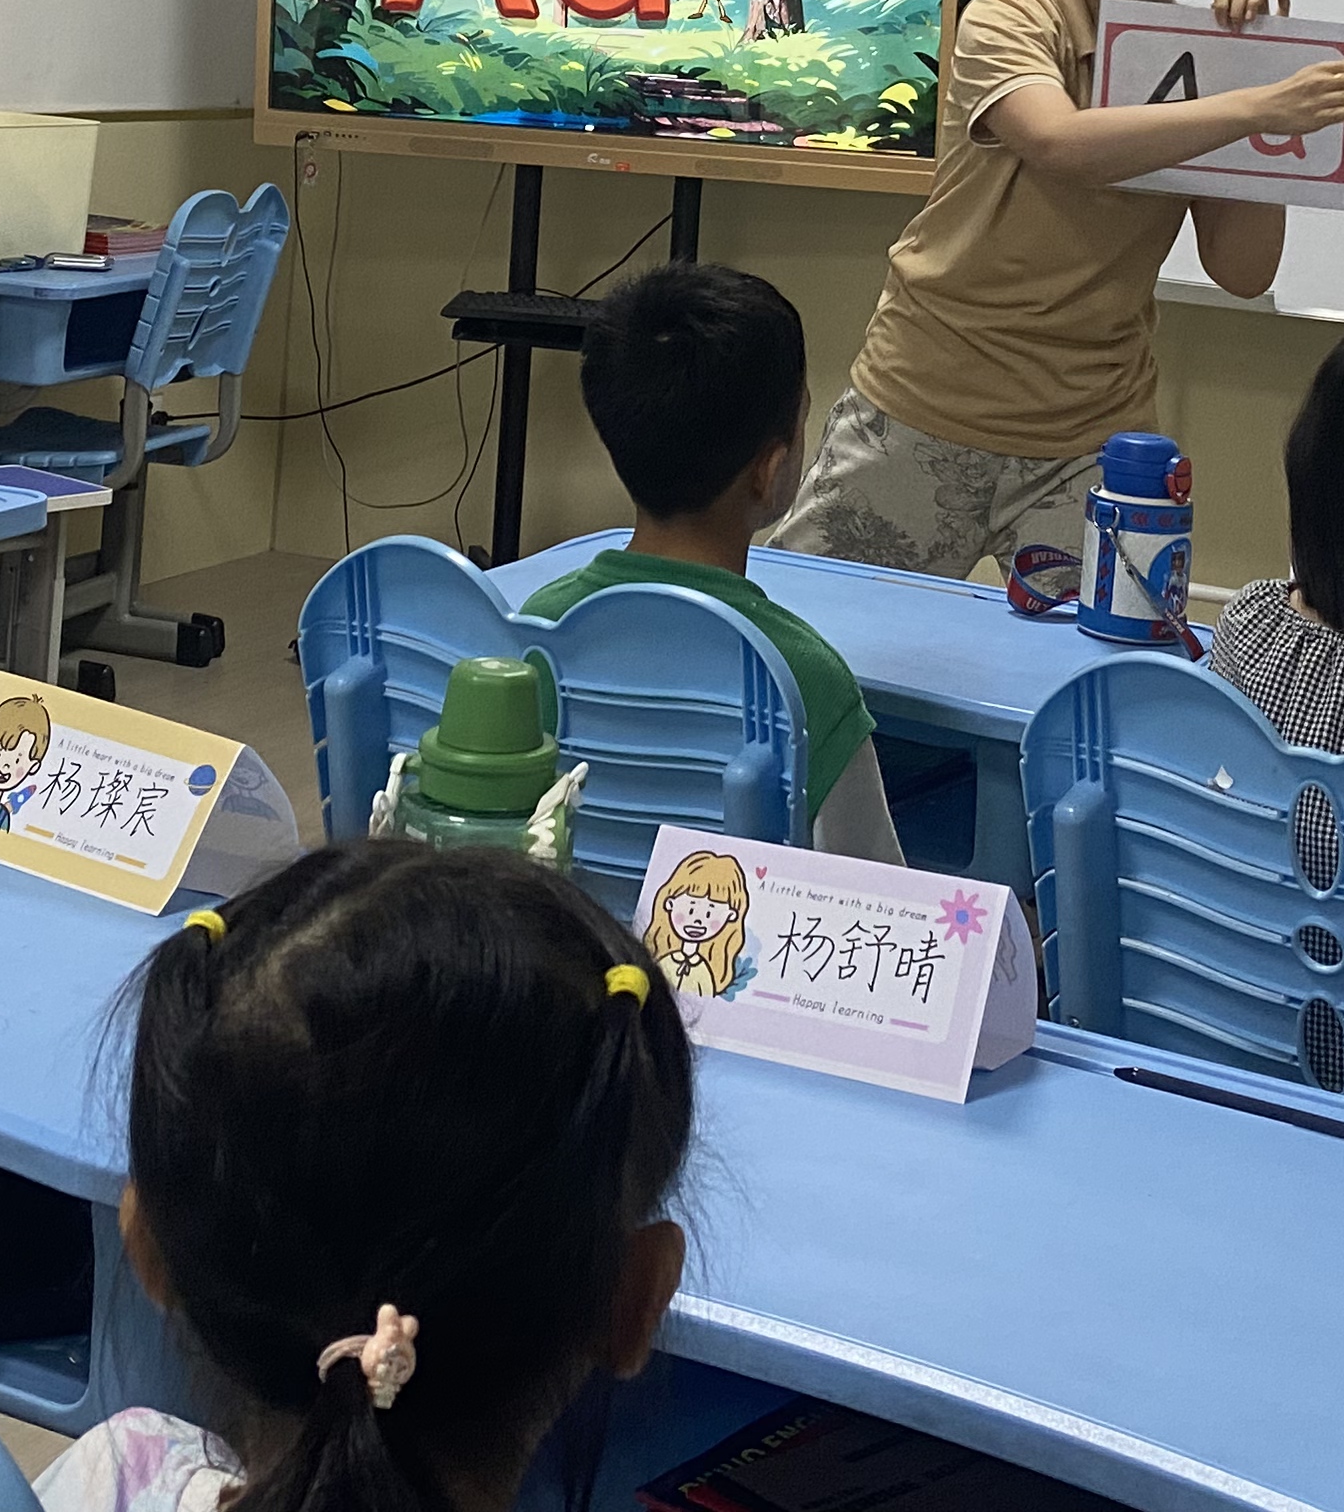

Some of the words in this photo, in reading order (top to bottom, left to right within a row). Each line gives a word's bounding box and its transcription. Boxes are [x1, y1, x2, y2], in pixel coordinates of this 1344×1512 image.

[39, 756, 170, 838] 杨璨宸
[759, 880, 766, 891] A
[770, 881, 802, 898] little
[806, 890, 834, 904] heart
[876, 902, 894, 916] big
[898, 907, 928, 922] dream
[768, 910, 946, 1005] 杨舒晴
[792, 993, 827, 1013] Happy
[831, 1000, 885, 1025] learning
